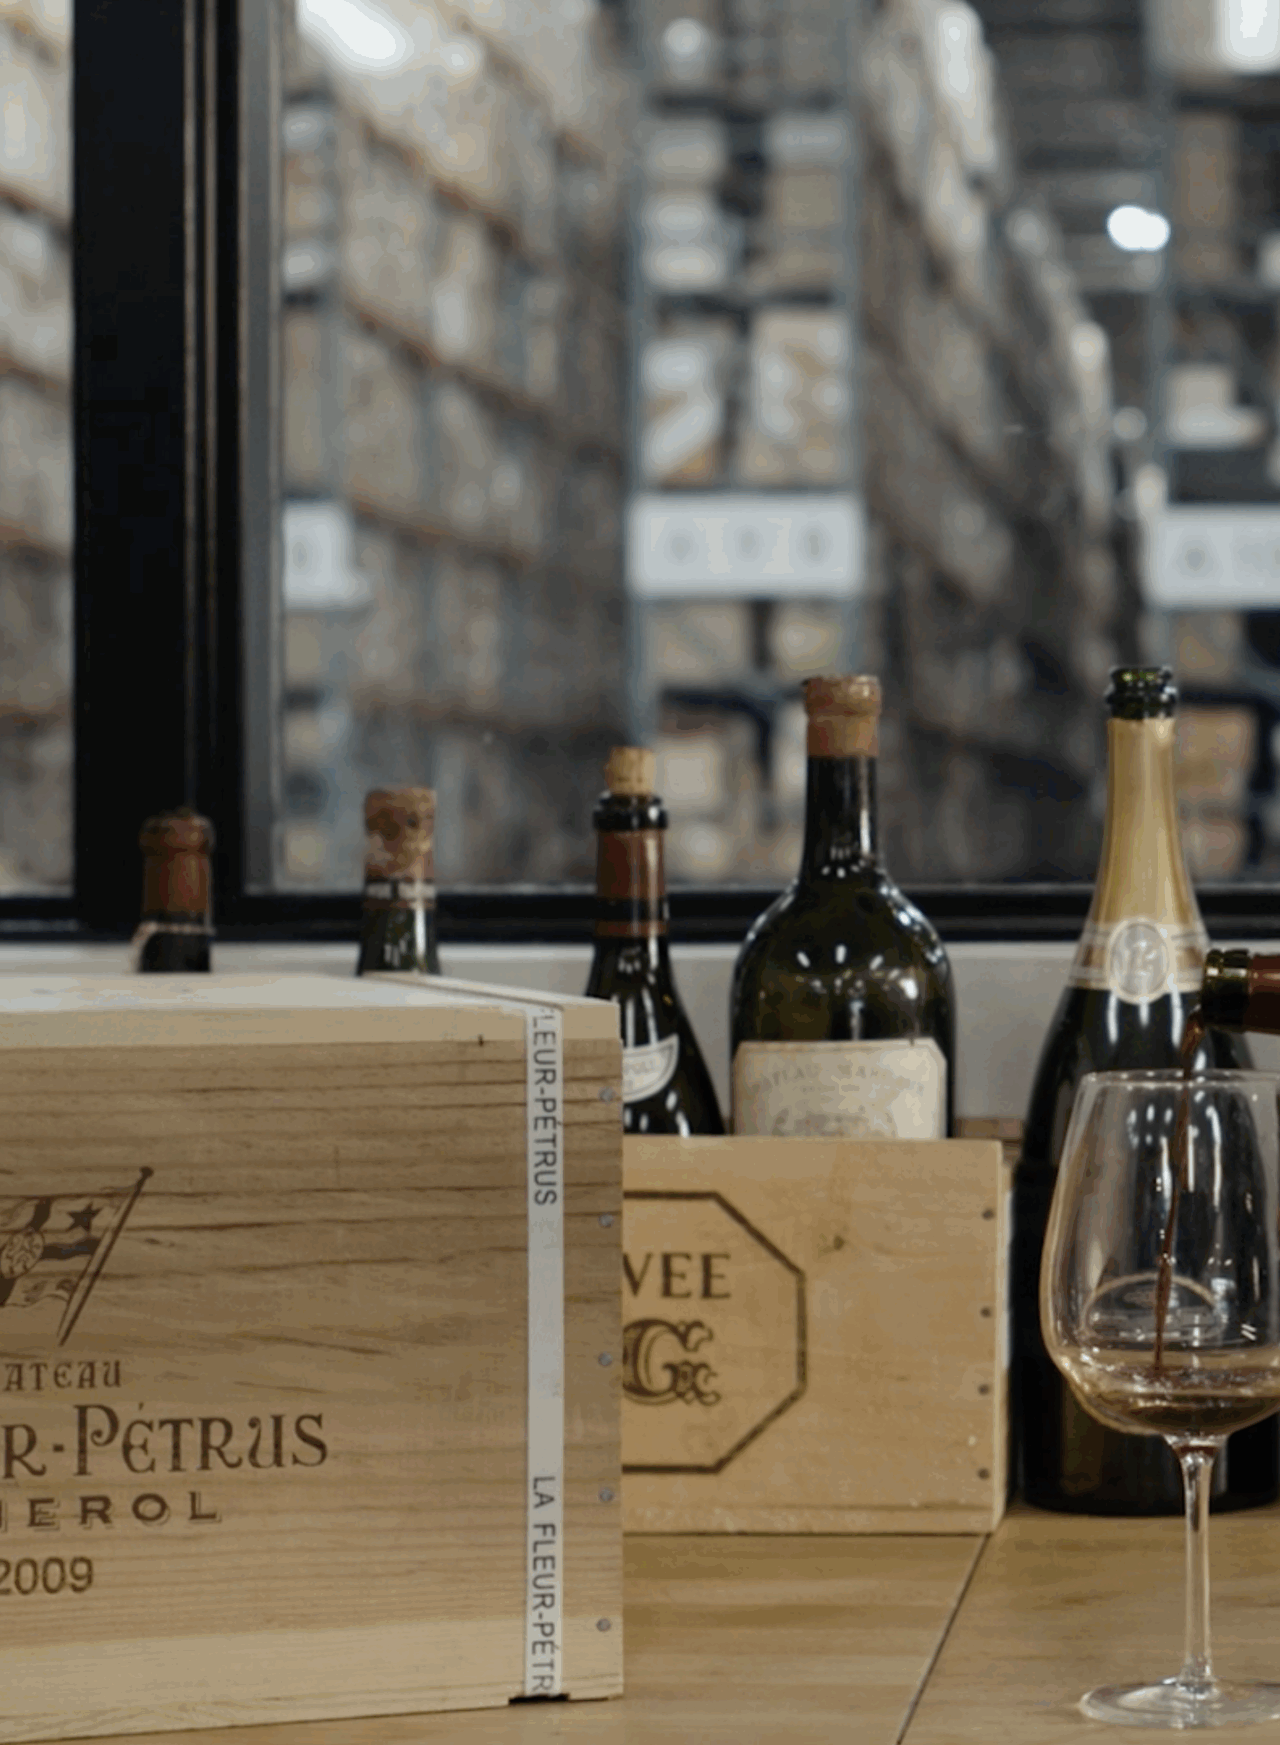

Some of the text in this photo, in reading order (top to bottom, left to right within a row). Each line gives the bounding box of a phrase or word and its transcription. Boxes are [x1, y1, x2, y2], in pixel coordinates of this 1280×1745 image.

[532, 1006, 562, 1206] LEUR-PÉTRUS
[623, 1252, 732, 1299] VEE
[2, 1359, 122, 1392] ATEAU
[0, 1490, 222, 1533] EROL
[531, 1476, 560, 1693] LA FLEUR-PÉTR
